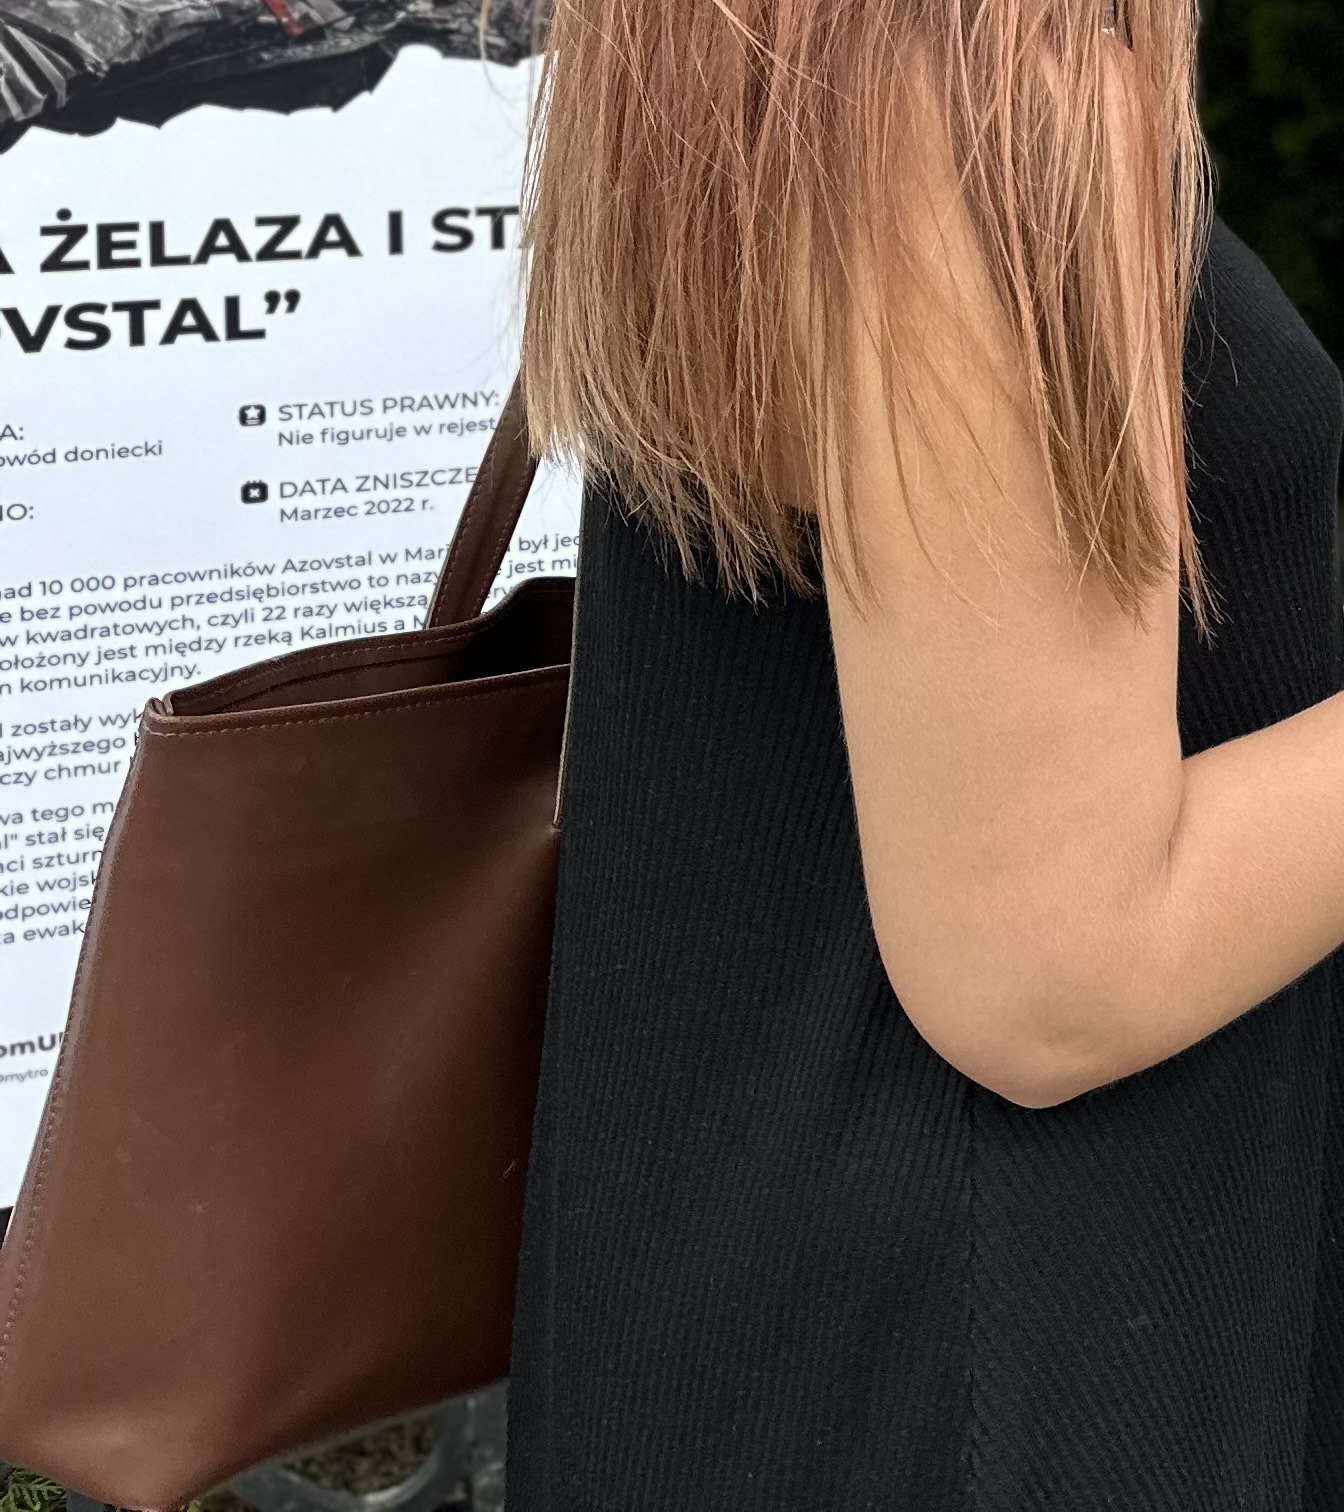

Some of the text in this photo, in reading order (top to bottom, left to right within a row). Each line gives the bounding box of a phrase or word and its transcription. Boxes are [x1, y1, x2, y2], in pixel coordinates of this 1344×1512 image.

[40, 207, 363, 273] ŻELAZA
[388, 210, 403, 256] I
[432, 206, 530, 254] ST
[0, 288, 301, 354] VSTAL”
[278, 390, 499, 422] STATUS PRAWNY:
[278, 416, 497, 446] Nie figuruje w rejest
[64, 439, 163, 463] doniecki
[280, 467, 479, 499] DATA ZNISZCZE
[280, 497, 434, 523] Marzec 2022 r.
[0, 582, 31, 600] ad
[39, 580, 63, 596] 10
[70, 575, 116, 593] 000
[123, 561, 276, 592] pracowników
[281, 551, 372, 574] Azovstal
[378, 551, 398, 564] w
[518, 534, 548, 554] był
[20, 606, 61, 622] bez
[69, 595, 162, 621] powodu
[170, 578, 361, 611] przedsiębiorstwo
[367, 573, 389, 588] to
[506, 559, 545, 578] jest
[551, 554, 577, 570] mi
[26, 614, 200, 645] kwadratowych,
[207, 607, 255, 628] czyli
[261, 605, 287, 622] 22
[294, 603, 338, 619] razy
[343, 594, 428, 615] większą
[94, 644, 137, 666] jest
[144, 635, 227, 657] między
[234, 628, 293, 648] rzeką
[300, 619, 388, 641] Kalmius
[394, 619, 405, 631] a
[20, 661, 201, 694] komunikacyjny.
[11, 714, 92, 737] zostały
[44, 760, 121, 780] chmur
[31, 805, 85, 822] tego
[25, 826, 67, 846] stał
[73, 823, 105, 842] się
[0, 896, 91, 922] dpowie
[23, 920, 85, 941] ewak
